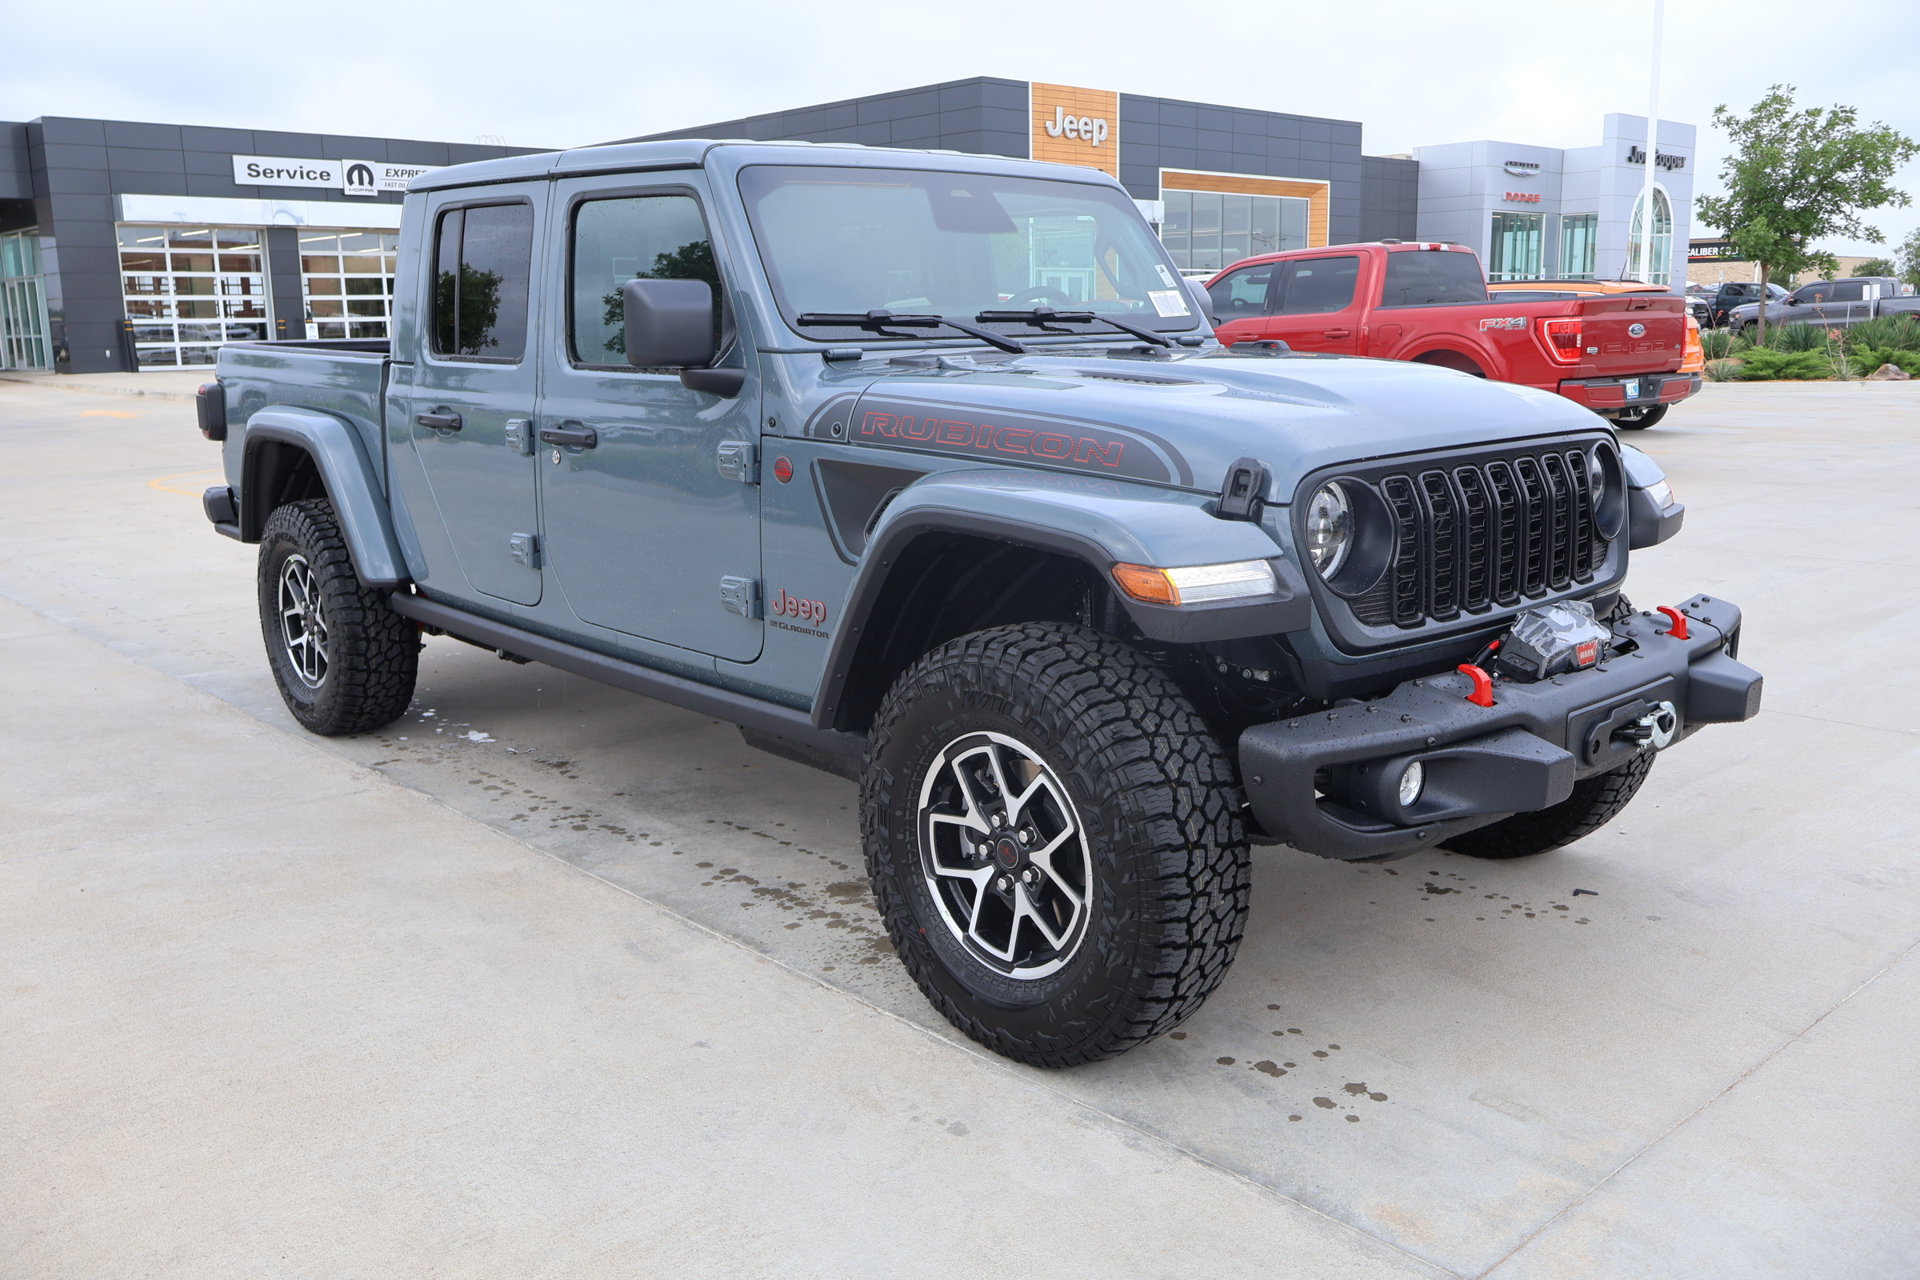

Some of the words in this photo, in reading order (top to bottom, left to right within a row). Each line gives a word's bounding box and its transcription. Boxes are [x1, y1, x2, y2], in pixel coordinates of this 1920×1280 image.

[1045, 106, 1108, 147] Jeep
[1626, 145, 1646, 164] Jo
[247, 163, 331, 181] Service
[385, 168, 428, 178] EXPRE
[1687, 247, 1718, 256] CALIBER
[1479, 317, 1527, 331] FX4
[861, 411, 1126, 467] RUBICON
[771, 588, 827, 627] Jeep
[778, 622, 829, 639] GLADIATOR
